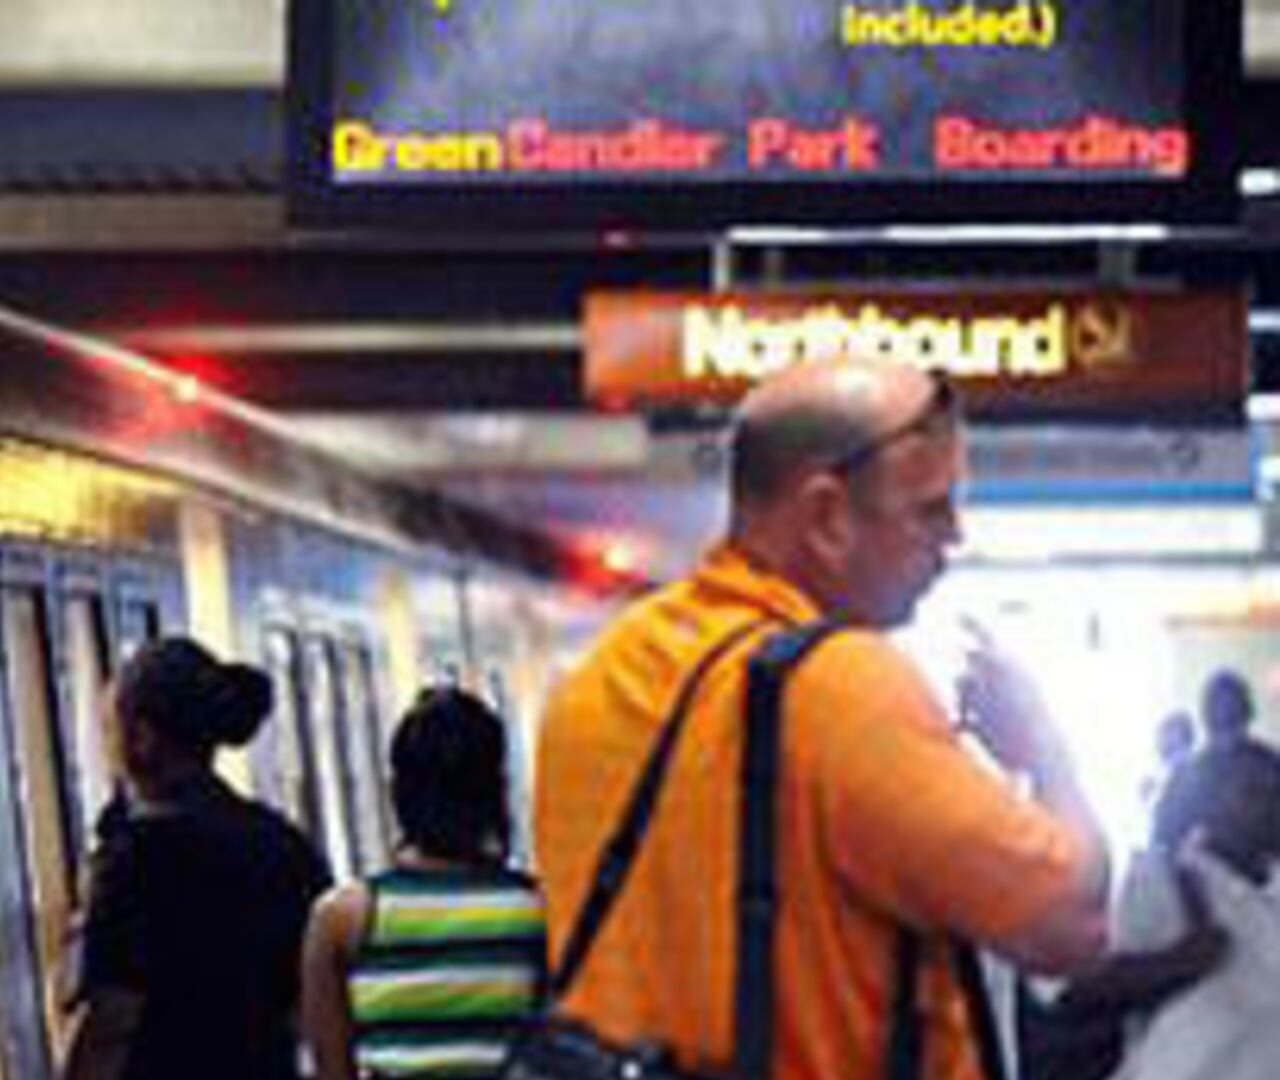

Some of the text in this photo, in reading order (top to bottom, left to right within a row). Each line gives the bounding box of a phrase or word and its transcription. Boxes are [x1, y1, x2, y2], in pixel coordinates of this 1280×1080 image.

[332, 115, 1188, 177] Green Candler Park Boarding
[681, 304, 1068, 378] Northbound
